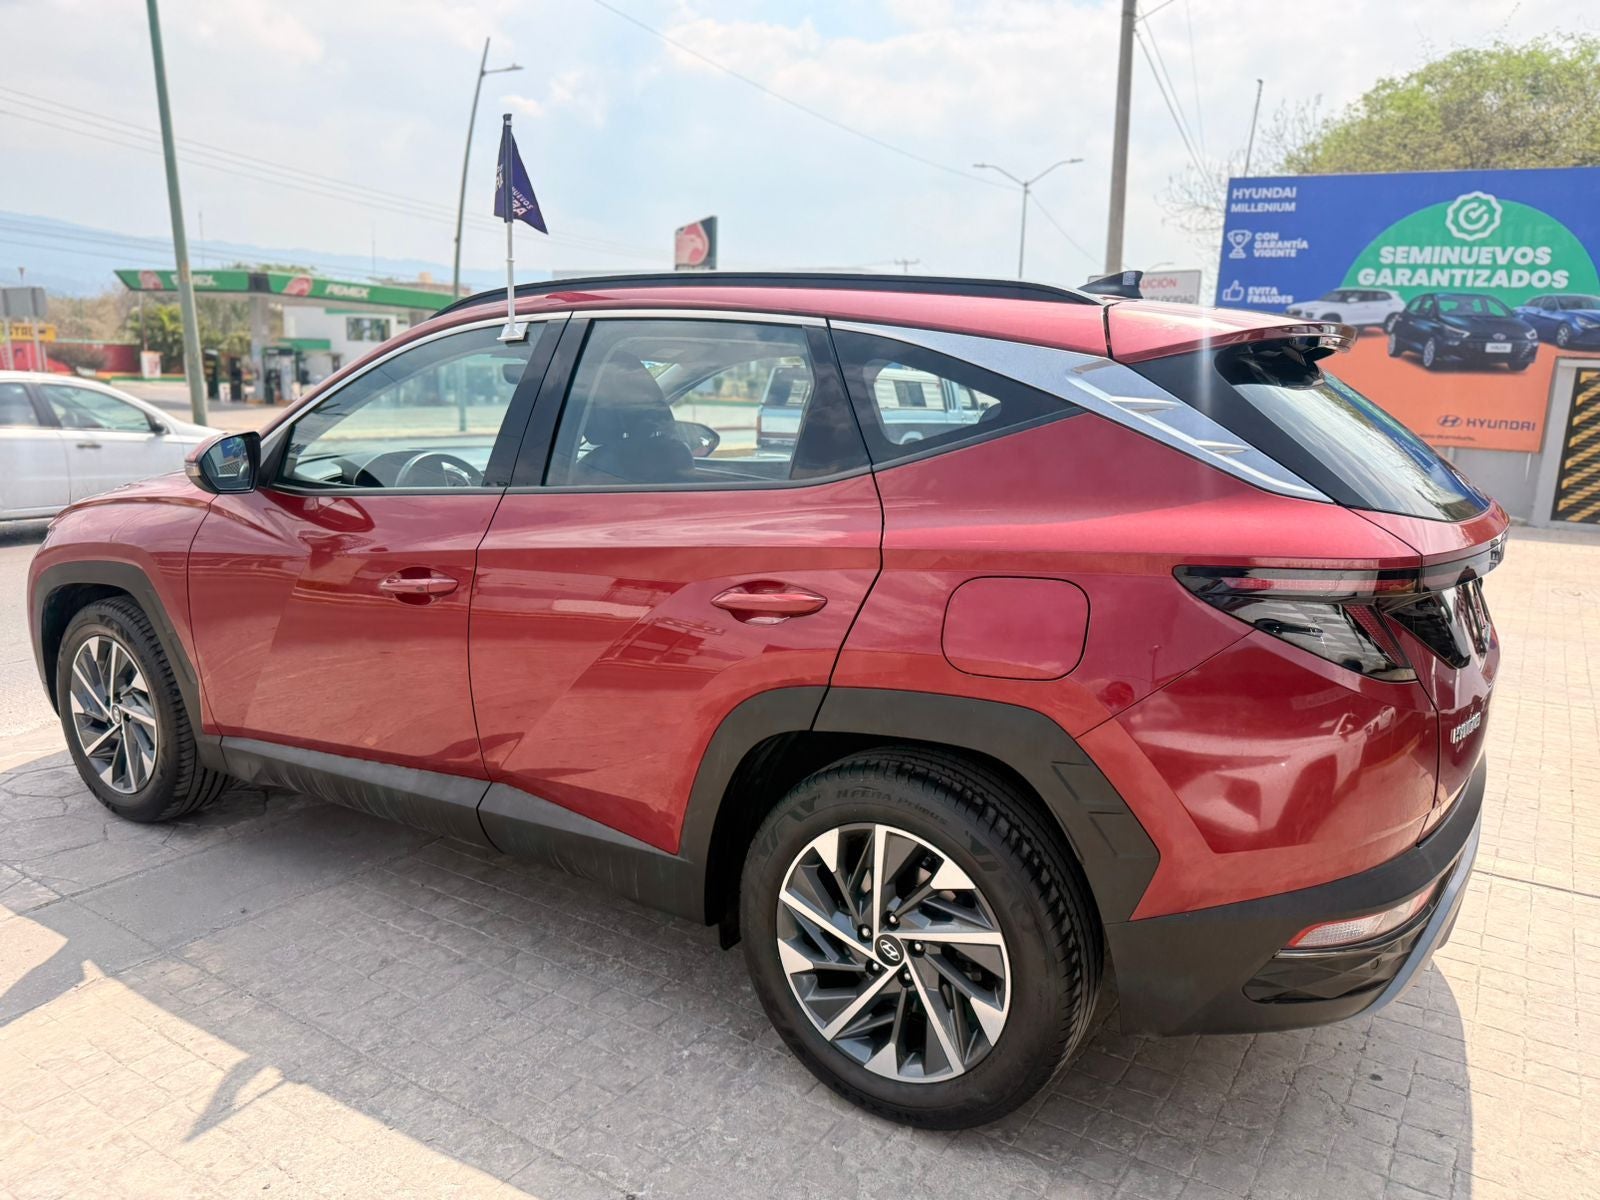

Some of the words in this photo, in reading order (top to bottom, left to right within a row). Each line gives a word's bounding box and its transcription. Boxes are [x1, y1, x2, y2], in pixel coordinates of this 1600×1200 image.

[1232, 186, 1297, 199] HYUNDAI
[1230, 202, 1297, 213] MILLENIUM
[1255, 232, 1279, 240] CON
[1254, 237, 1309, 249] GARANTÍA
[1253, 249, 1297, 258] VIGENTE
[1379, 245, 1552, 266] SEMINUEVOS
[170, 274, 217, 286] PMEX
[1357, 267, 1570, 289] GARANTIZADOS
[325, 284, 371, 298] PEMEX
[1247, 286, 1279, 295] EVITA
[1247, 294, 1294, 304] FRAUDES
[1466, 417, 1537, 432] HYUNDAI
